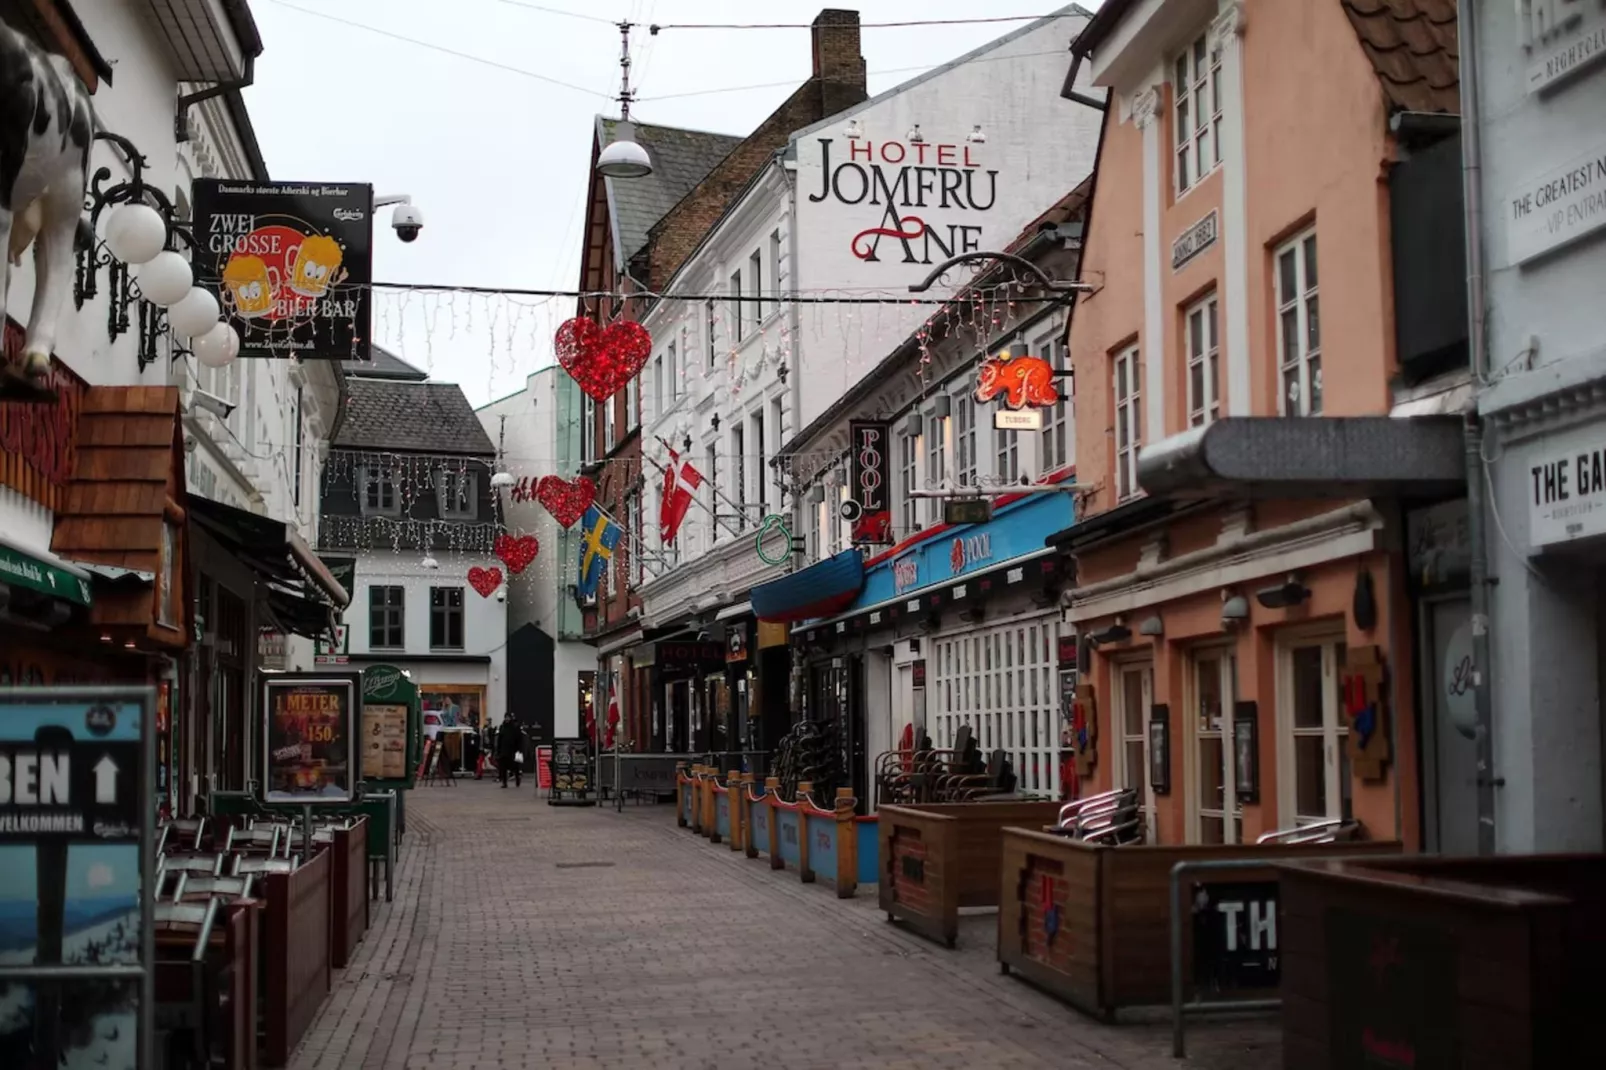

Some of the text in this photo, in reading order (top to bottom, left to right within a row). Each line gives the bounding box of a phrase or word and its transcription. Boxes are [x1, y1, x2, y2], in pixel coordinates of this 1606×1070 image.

[851, 140, 981, 167] HOTEL
[809, 138, 999, 210] JOMFRU
[218, 183, 254, 195] Danmarks
[311, 188, 319, 197] og
[1513, 194, 1532, 220] THE
[1536, 162, 1594, 209] GREATEST
[210, 213, 255, 234] ZWEI
[852, 200, 983, 266] ANE
[1547, 209, 1564, 235] VIP
[209, 234, 282, 254] GROSSE
[277, 299, 357, 318] BIER BAR
[860, 429, 882, 509] POOL
[1531, 448, 1606, 506] THE GA
[287, 694, 340, 711] METER
